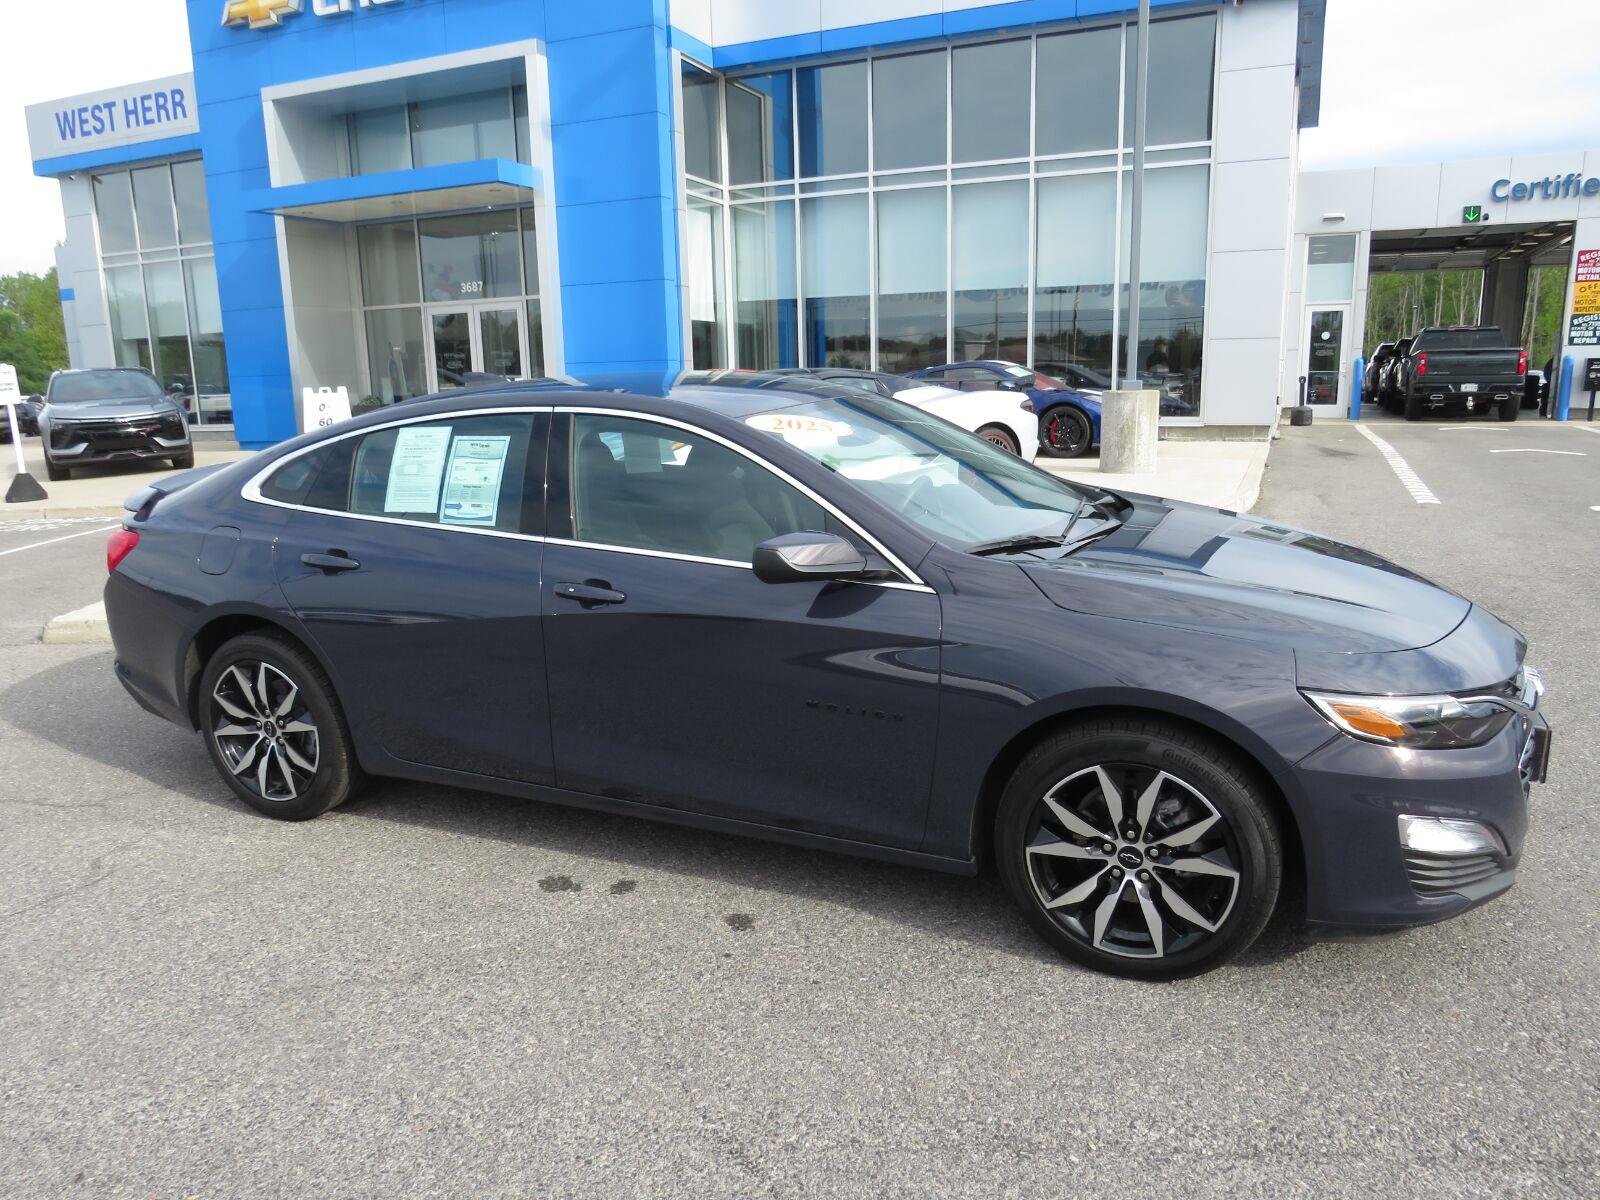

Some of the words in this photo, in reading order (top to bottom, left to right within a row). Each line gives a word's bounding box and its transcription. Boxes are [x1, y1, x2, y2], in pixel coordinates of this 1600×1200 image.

[55, 101, 117, 141] WEST
[123, 88, 187, 129] HERR
[1490, 173, 1600, 202] Certifie
[460, 281, 483, 292] 3687
[771, 417, 833, 432] 2025
